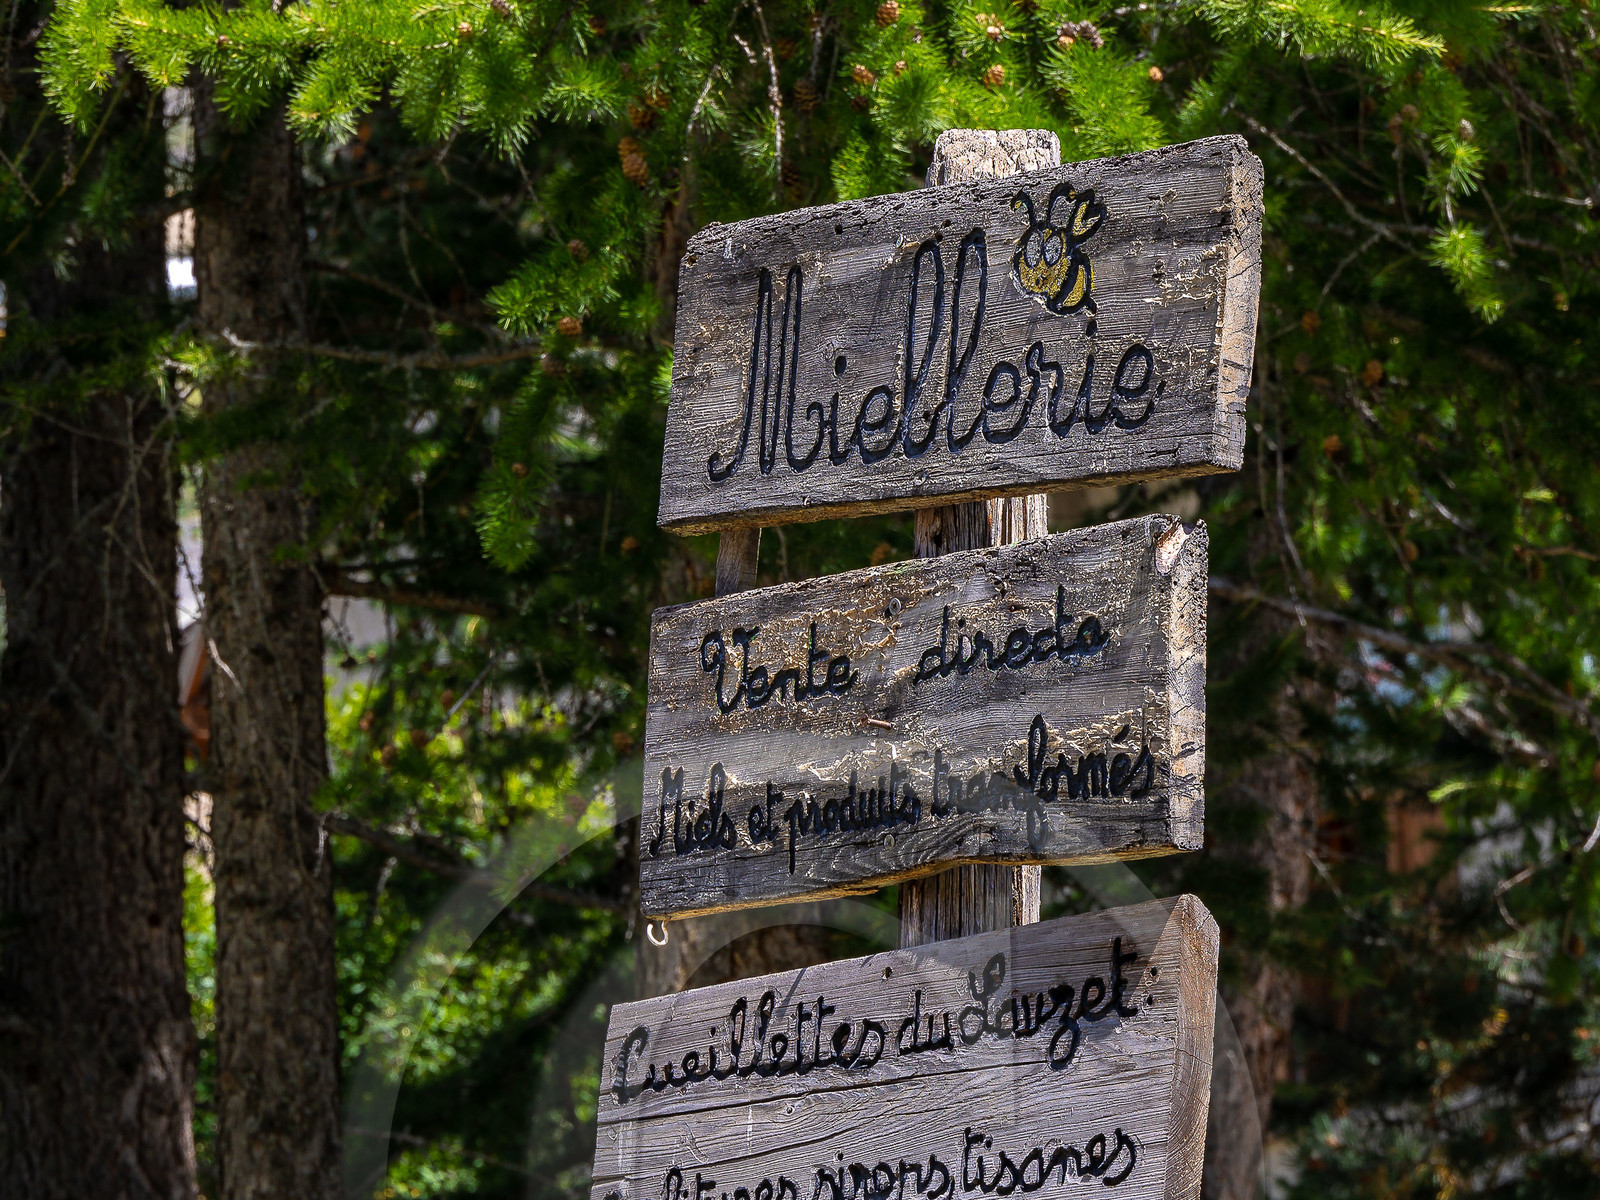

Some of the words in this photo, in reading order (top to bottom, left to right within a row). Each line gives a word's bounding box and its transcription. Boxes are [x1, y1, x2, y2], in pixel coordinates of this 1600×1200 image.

[707, 226, 1167, 482] Miellerie
[700, 622, 858, 714] Vente
[913, 585, 1110, 685] directe
[650, 761, 738, 857] Miels
[750, 780, 784, 843] et
[784, 762, 922, 875] produits
[611, 990, 886, 1103] Cueillettes
[898, 990, 955, 1055] du
[962, 1127, 1139, 1196] tisanes
